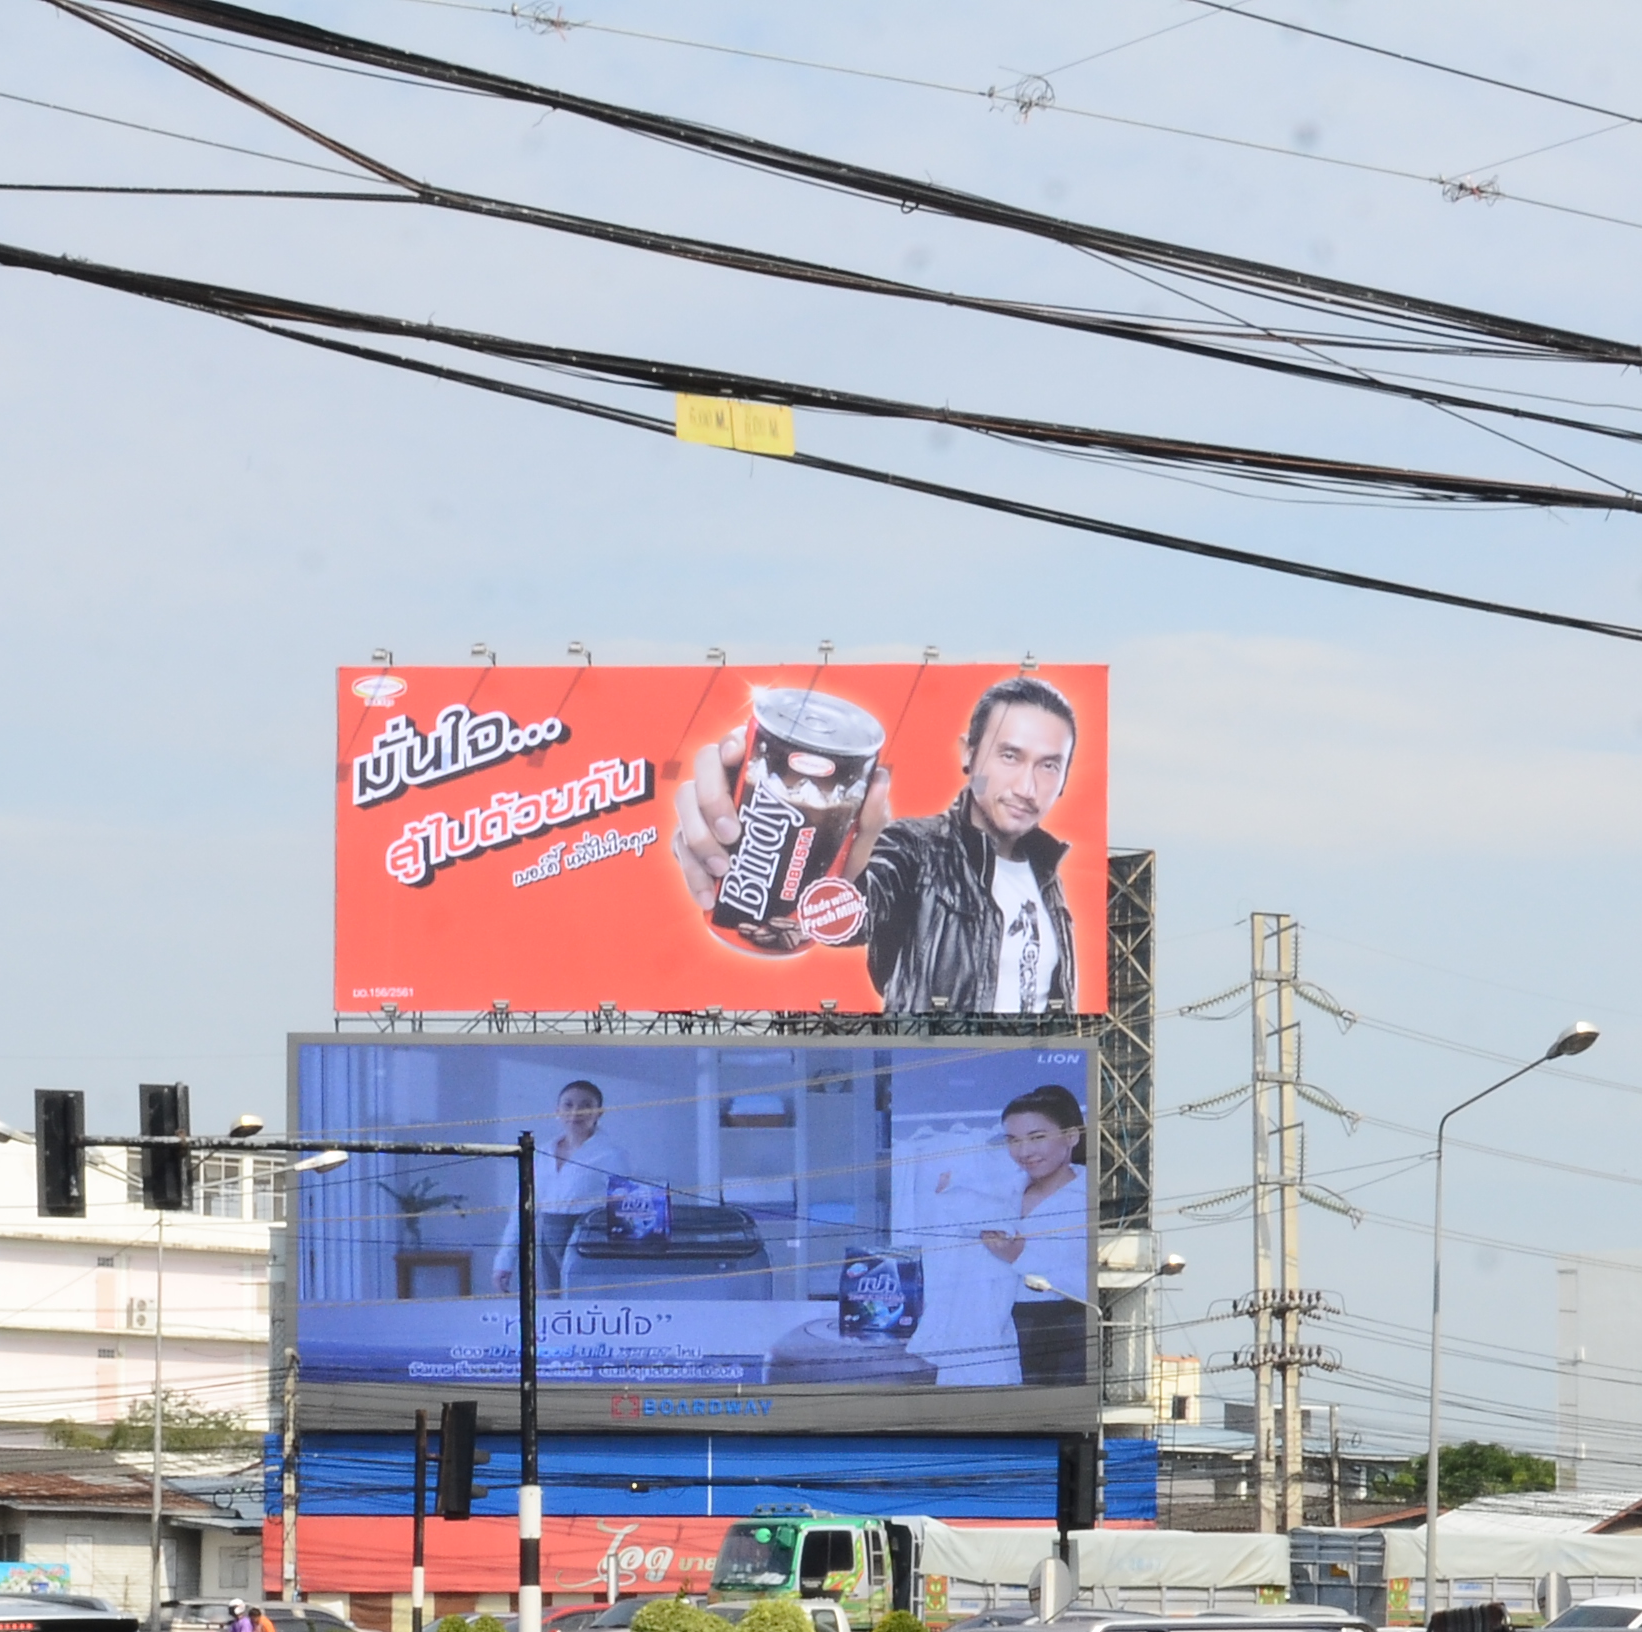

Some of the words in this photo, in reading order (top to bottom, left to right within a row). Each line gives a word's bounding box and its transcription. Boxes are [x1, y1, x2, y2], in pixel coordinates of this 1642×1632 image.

[719, 779, 806, 921] Birdy
[780, 826, 817, 902] ROBUSTA
[803, 897, 831, 917] Made
[831, 888, 855, 906] with
[804, 912, 836, 932] Fresh
[835, 896, 867, 921] Milk
[1037, 1053, 1081, 1065] LION
[643, 1398, 773, 1416] BOARDWAY
